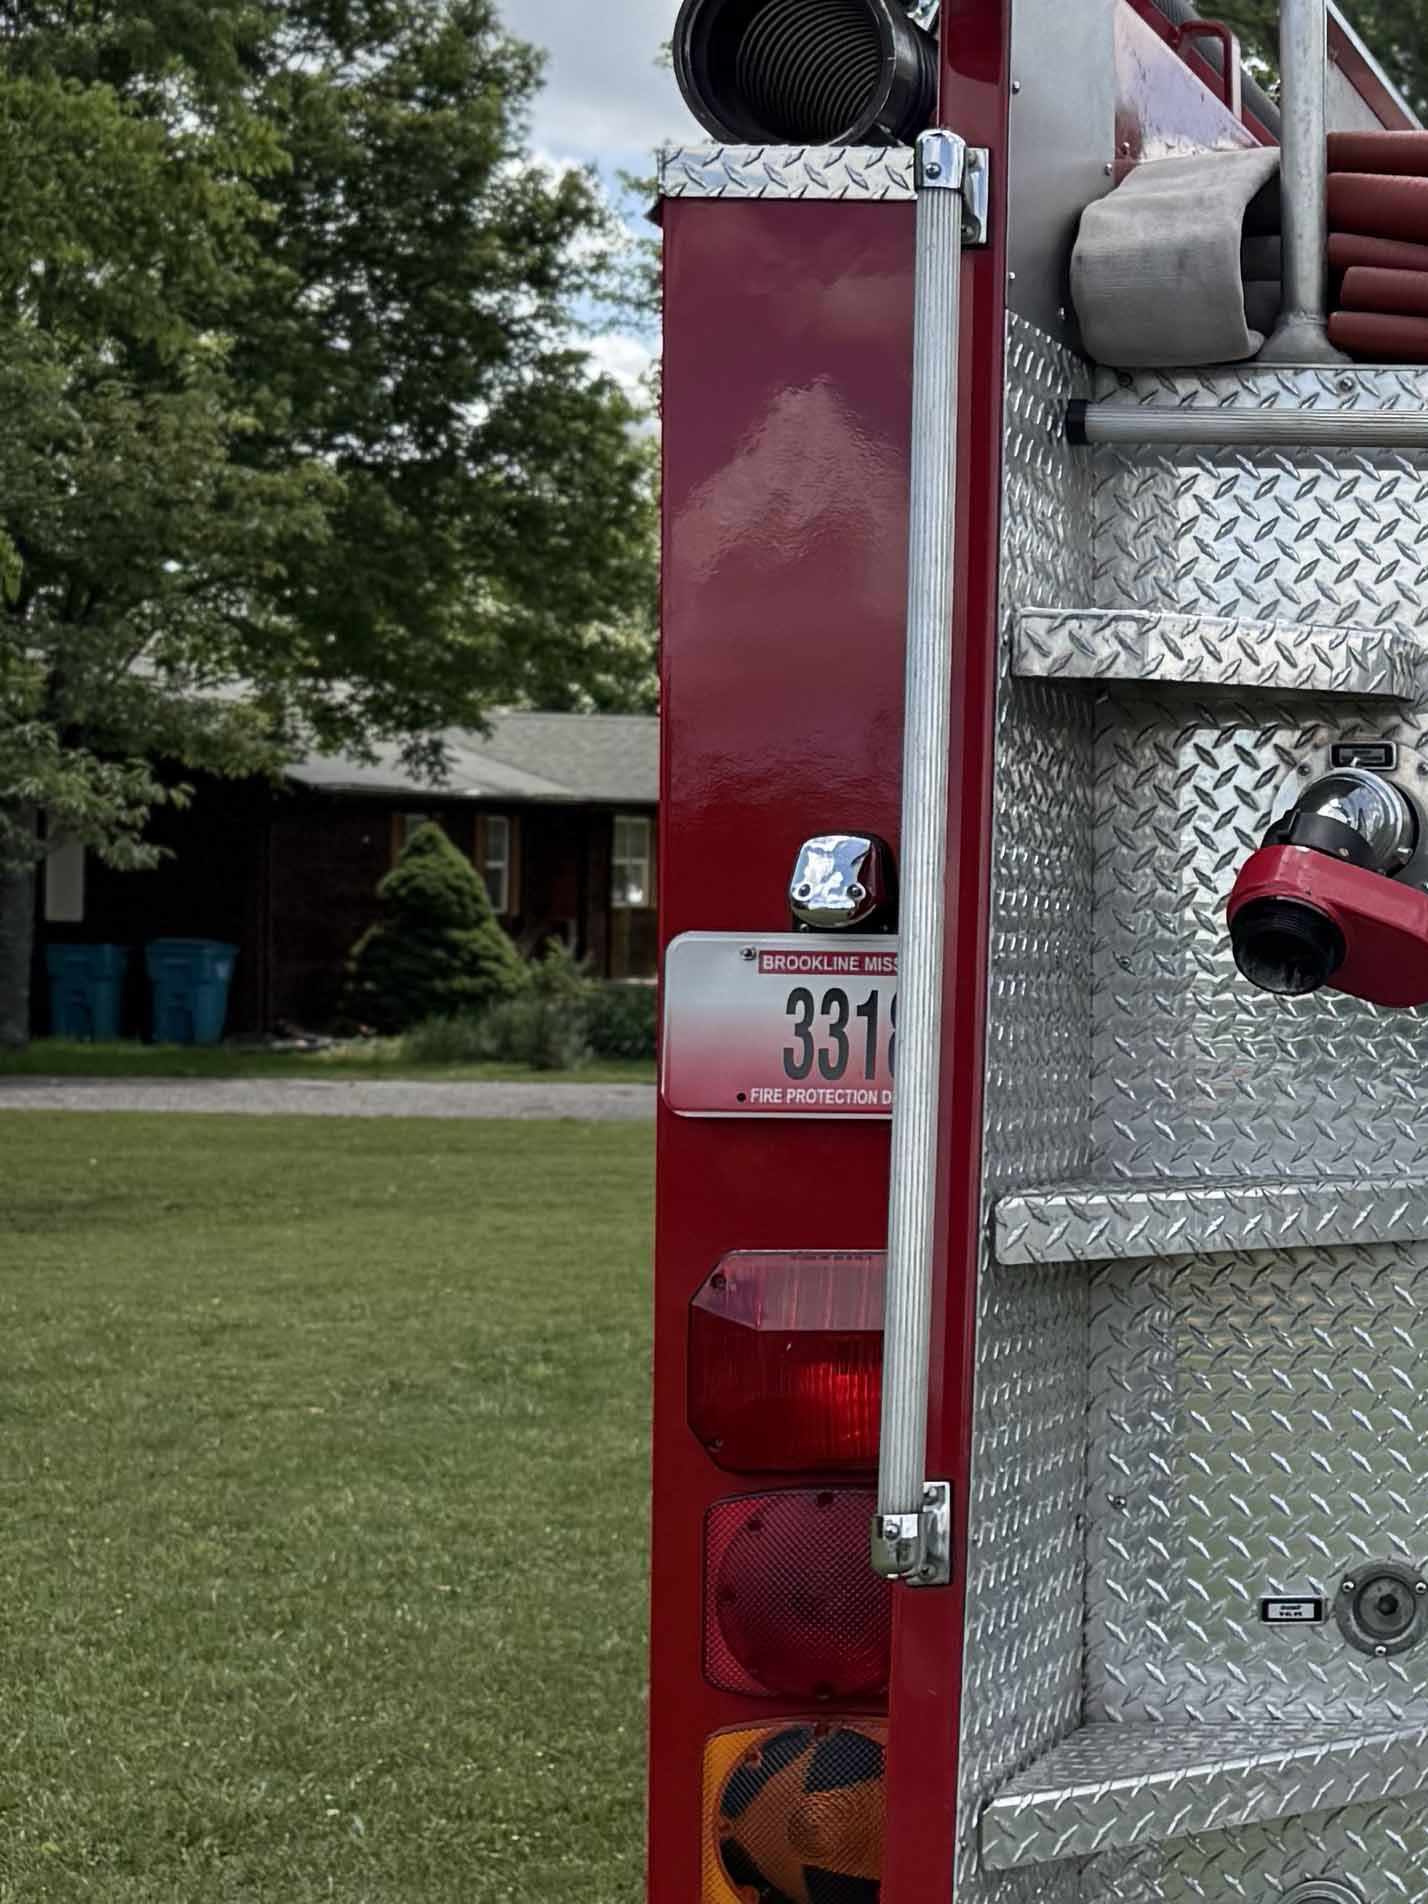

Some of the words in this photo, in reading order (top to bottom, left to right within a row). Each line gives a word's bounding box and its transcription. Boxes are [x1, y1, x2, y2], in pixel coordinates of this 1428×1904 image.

[762, 955, 859, 971] BROOKLINE
[750, 1088, 783, 1104] FIRE
[786, 1088, 878, 1105] PROTECTION
